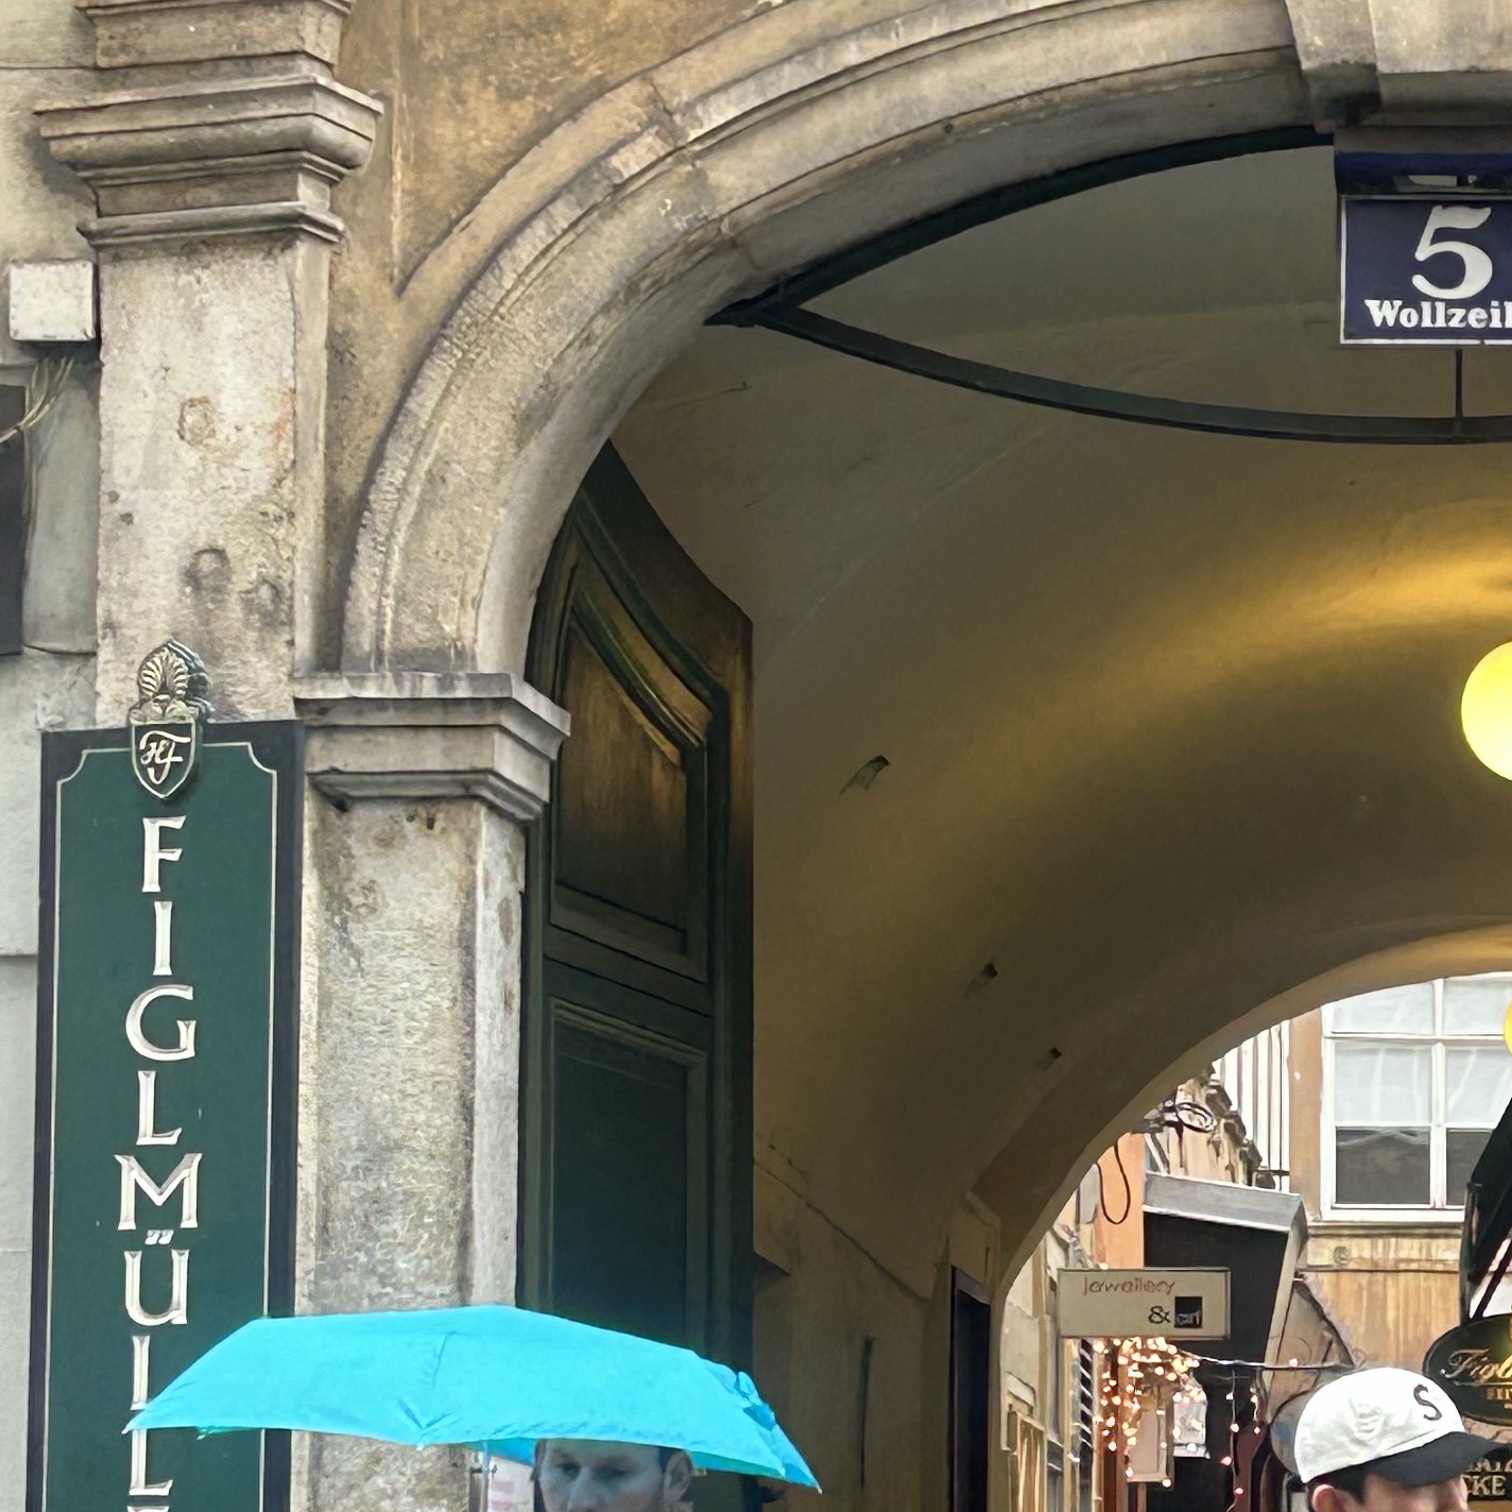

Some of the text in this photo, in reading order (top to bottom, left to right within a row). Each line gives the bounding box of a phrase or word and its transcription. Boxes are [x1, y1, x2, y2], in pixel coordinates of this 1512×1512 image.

[1412, 205, 1493, 299] 5
[1148, 1305, 1171, 1324] &
[1413, 1384, 1442, 1421] S
